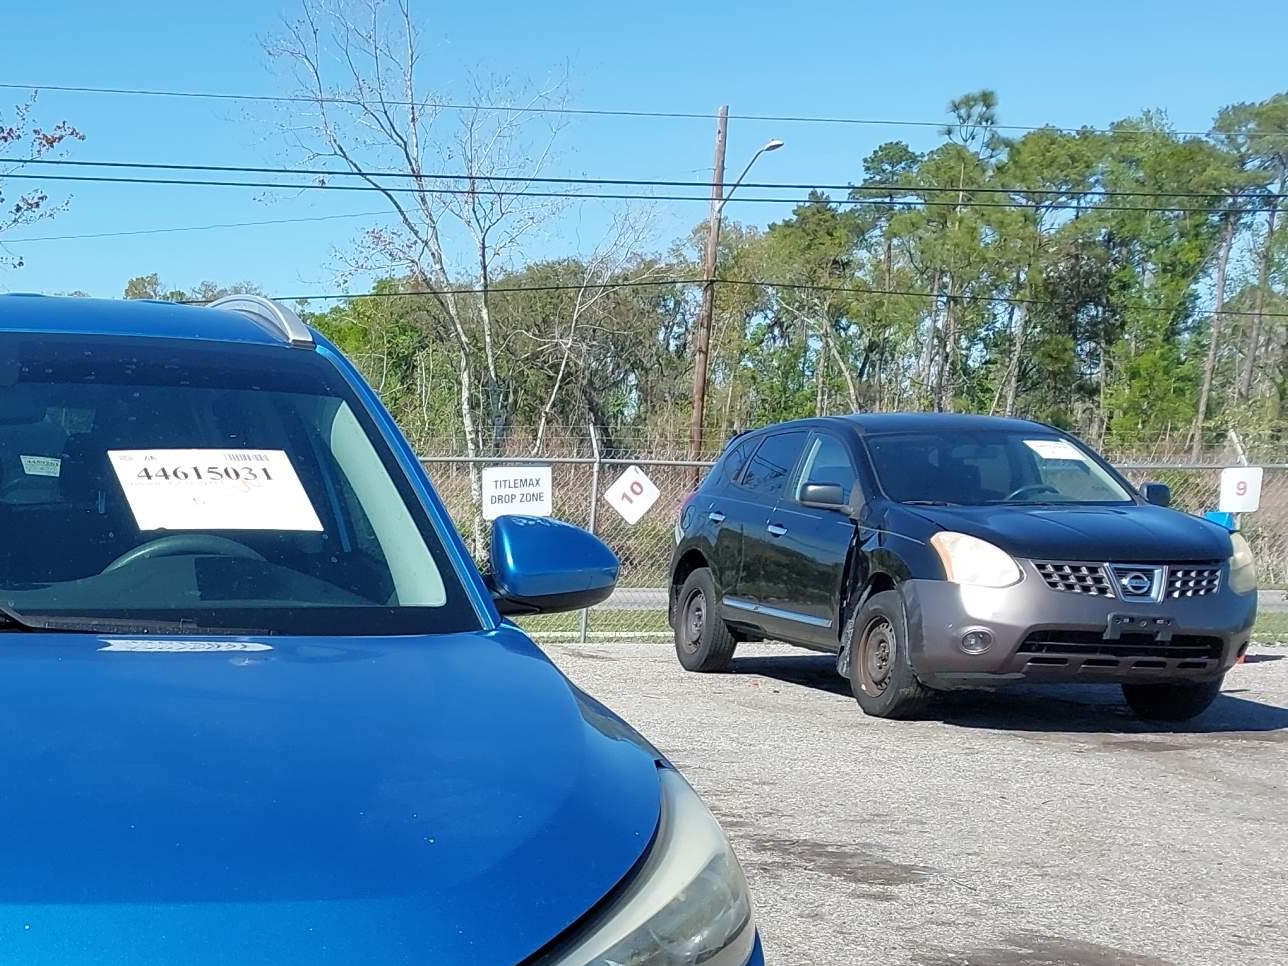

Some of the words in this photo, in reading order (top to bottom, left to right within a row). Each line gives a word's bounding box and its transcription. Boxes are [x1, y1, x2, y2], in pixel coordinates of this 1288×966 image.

[137, 466, 273, 480] 44615031
[494, 478, 541, 489] TITLEMAX
[1235, 481, 1247, 496] 9
[491, 494, 516, 505] DROP
[520, 492, 544, 502] ZONE
[621, 481, 643, 504] 10
